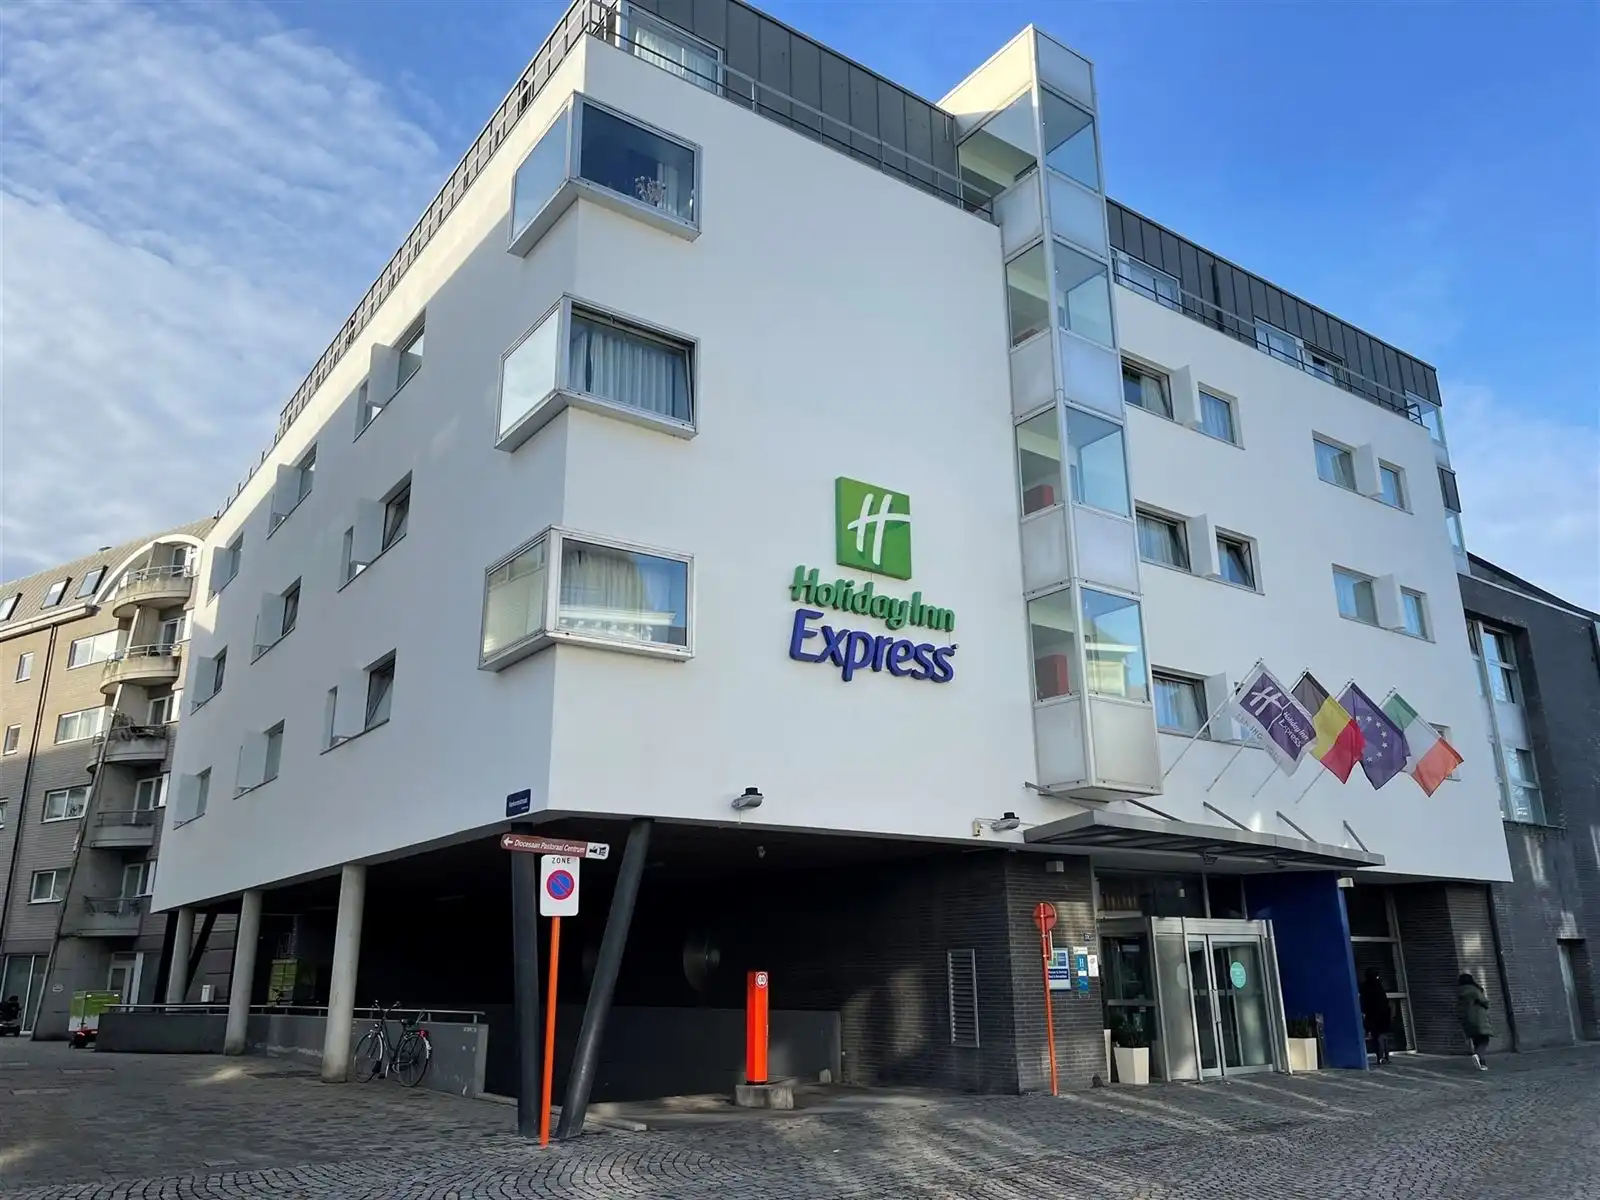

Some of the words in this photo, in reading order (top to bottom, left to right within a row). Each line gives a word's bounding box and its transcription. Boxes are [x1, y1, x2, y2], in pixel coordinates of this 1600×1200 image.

[788, 565, 910, 630] Holiday
[789, 608, 956, 683] Express
[1278, 718, 1302, 748] Express
[514, 839, 541, 849] Diocesaan
[540, 842, 564, 851] Pastoraal
[563, 844, 586, 853] Centrum
